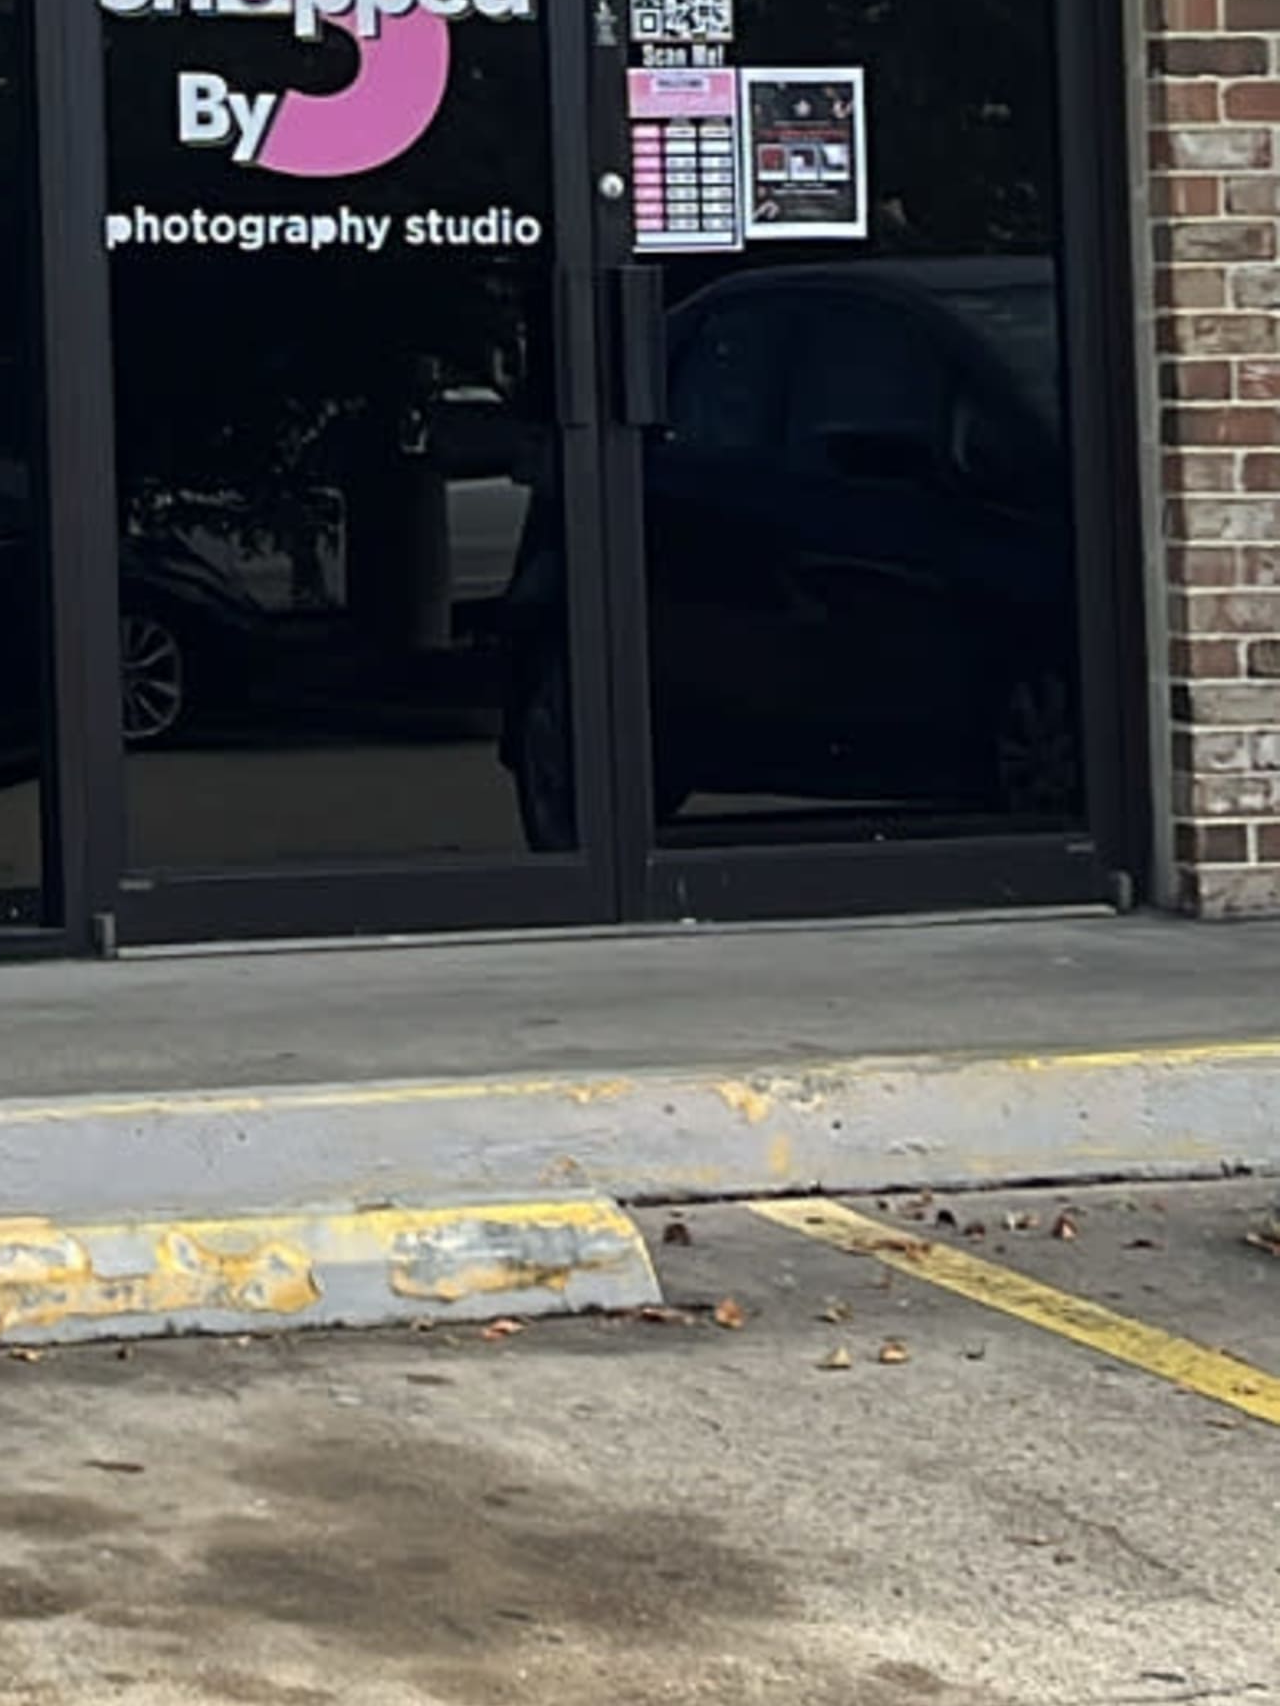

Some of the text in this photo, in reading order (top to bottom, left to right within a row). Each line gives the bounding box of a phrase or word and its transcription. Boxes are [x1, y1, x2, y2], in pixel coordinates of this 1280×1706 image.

[642, 43, 688, 67] Scan
[178, 71, 277, 163] By
[104, 204, 542, 251] photography studio
